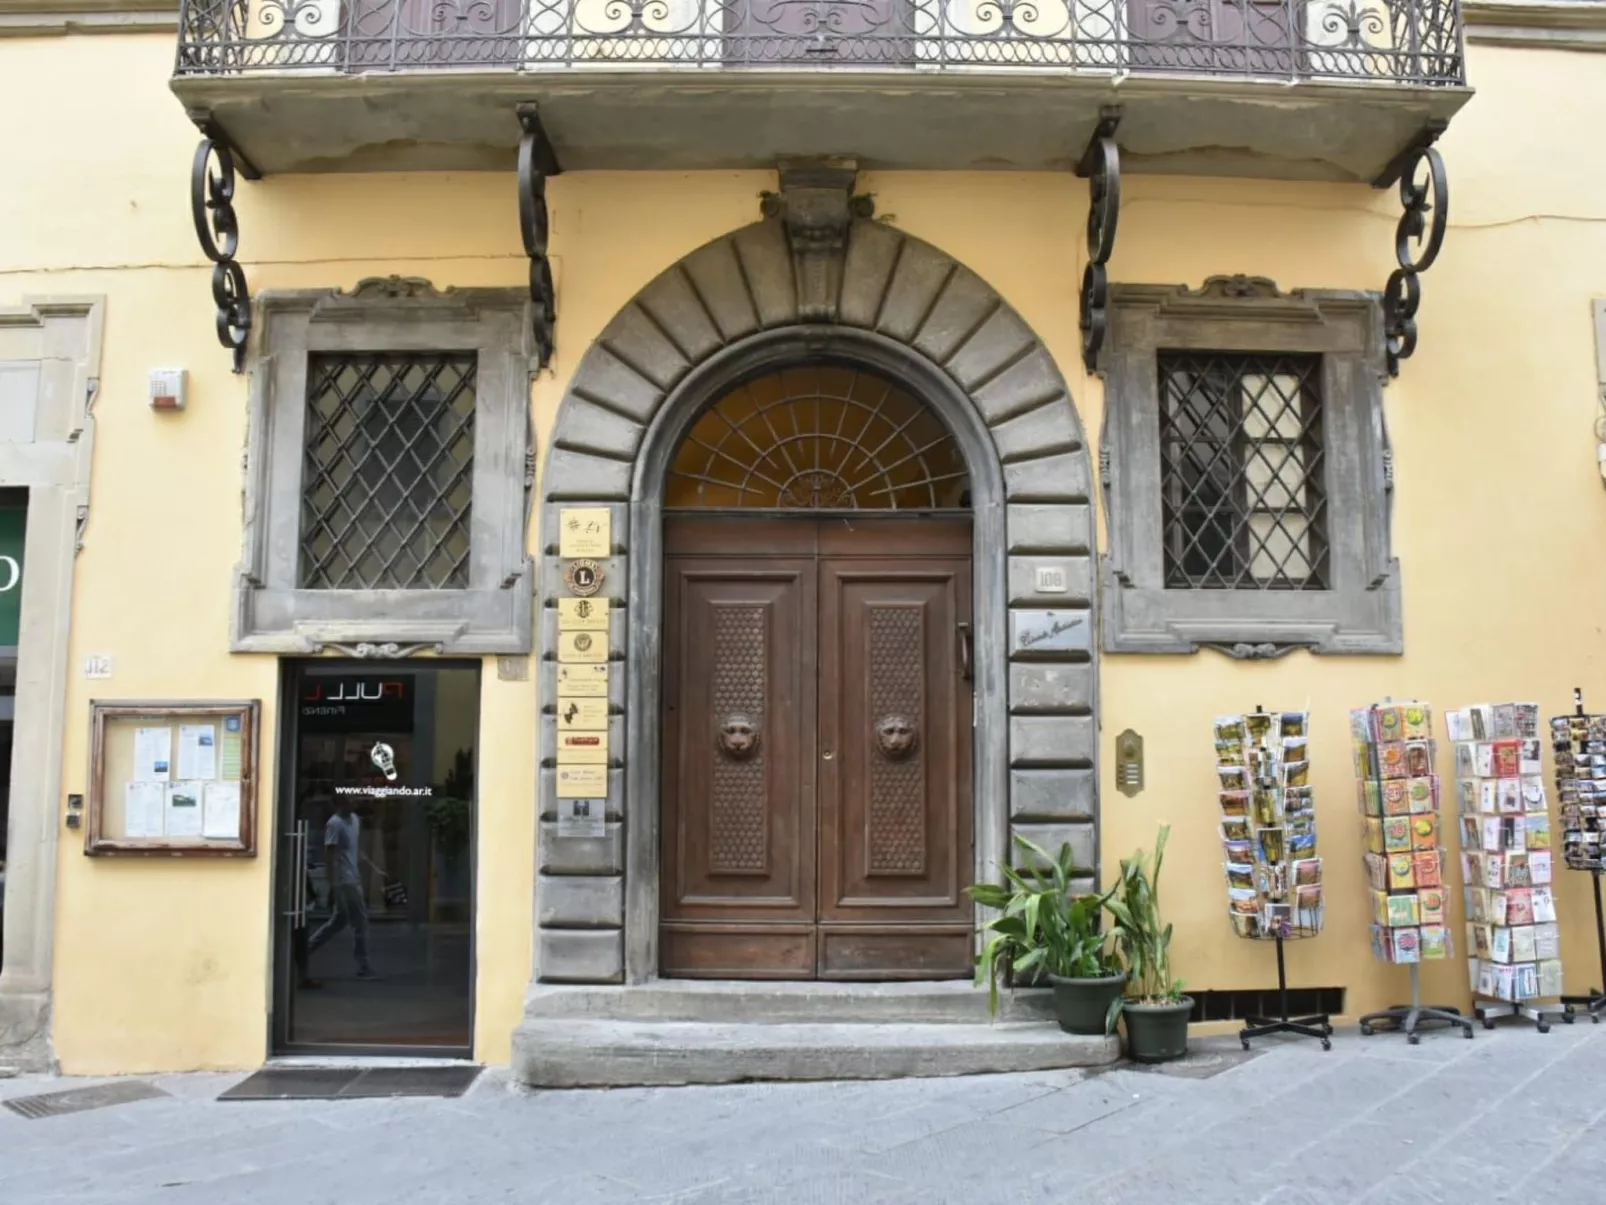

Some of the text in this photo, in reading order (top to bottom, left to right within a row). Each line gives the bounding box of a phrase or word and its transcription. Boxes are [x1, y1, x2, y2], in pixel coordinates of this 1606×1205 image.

[1041, 571, 1062, 588] 108
[85, 658, 110, 675] 112
[335, 785, 433, 799] www.viaggiando.ar.it
